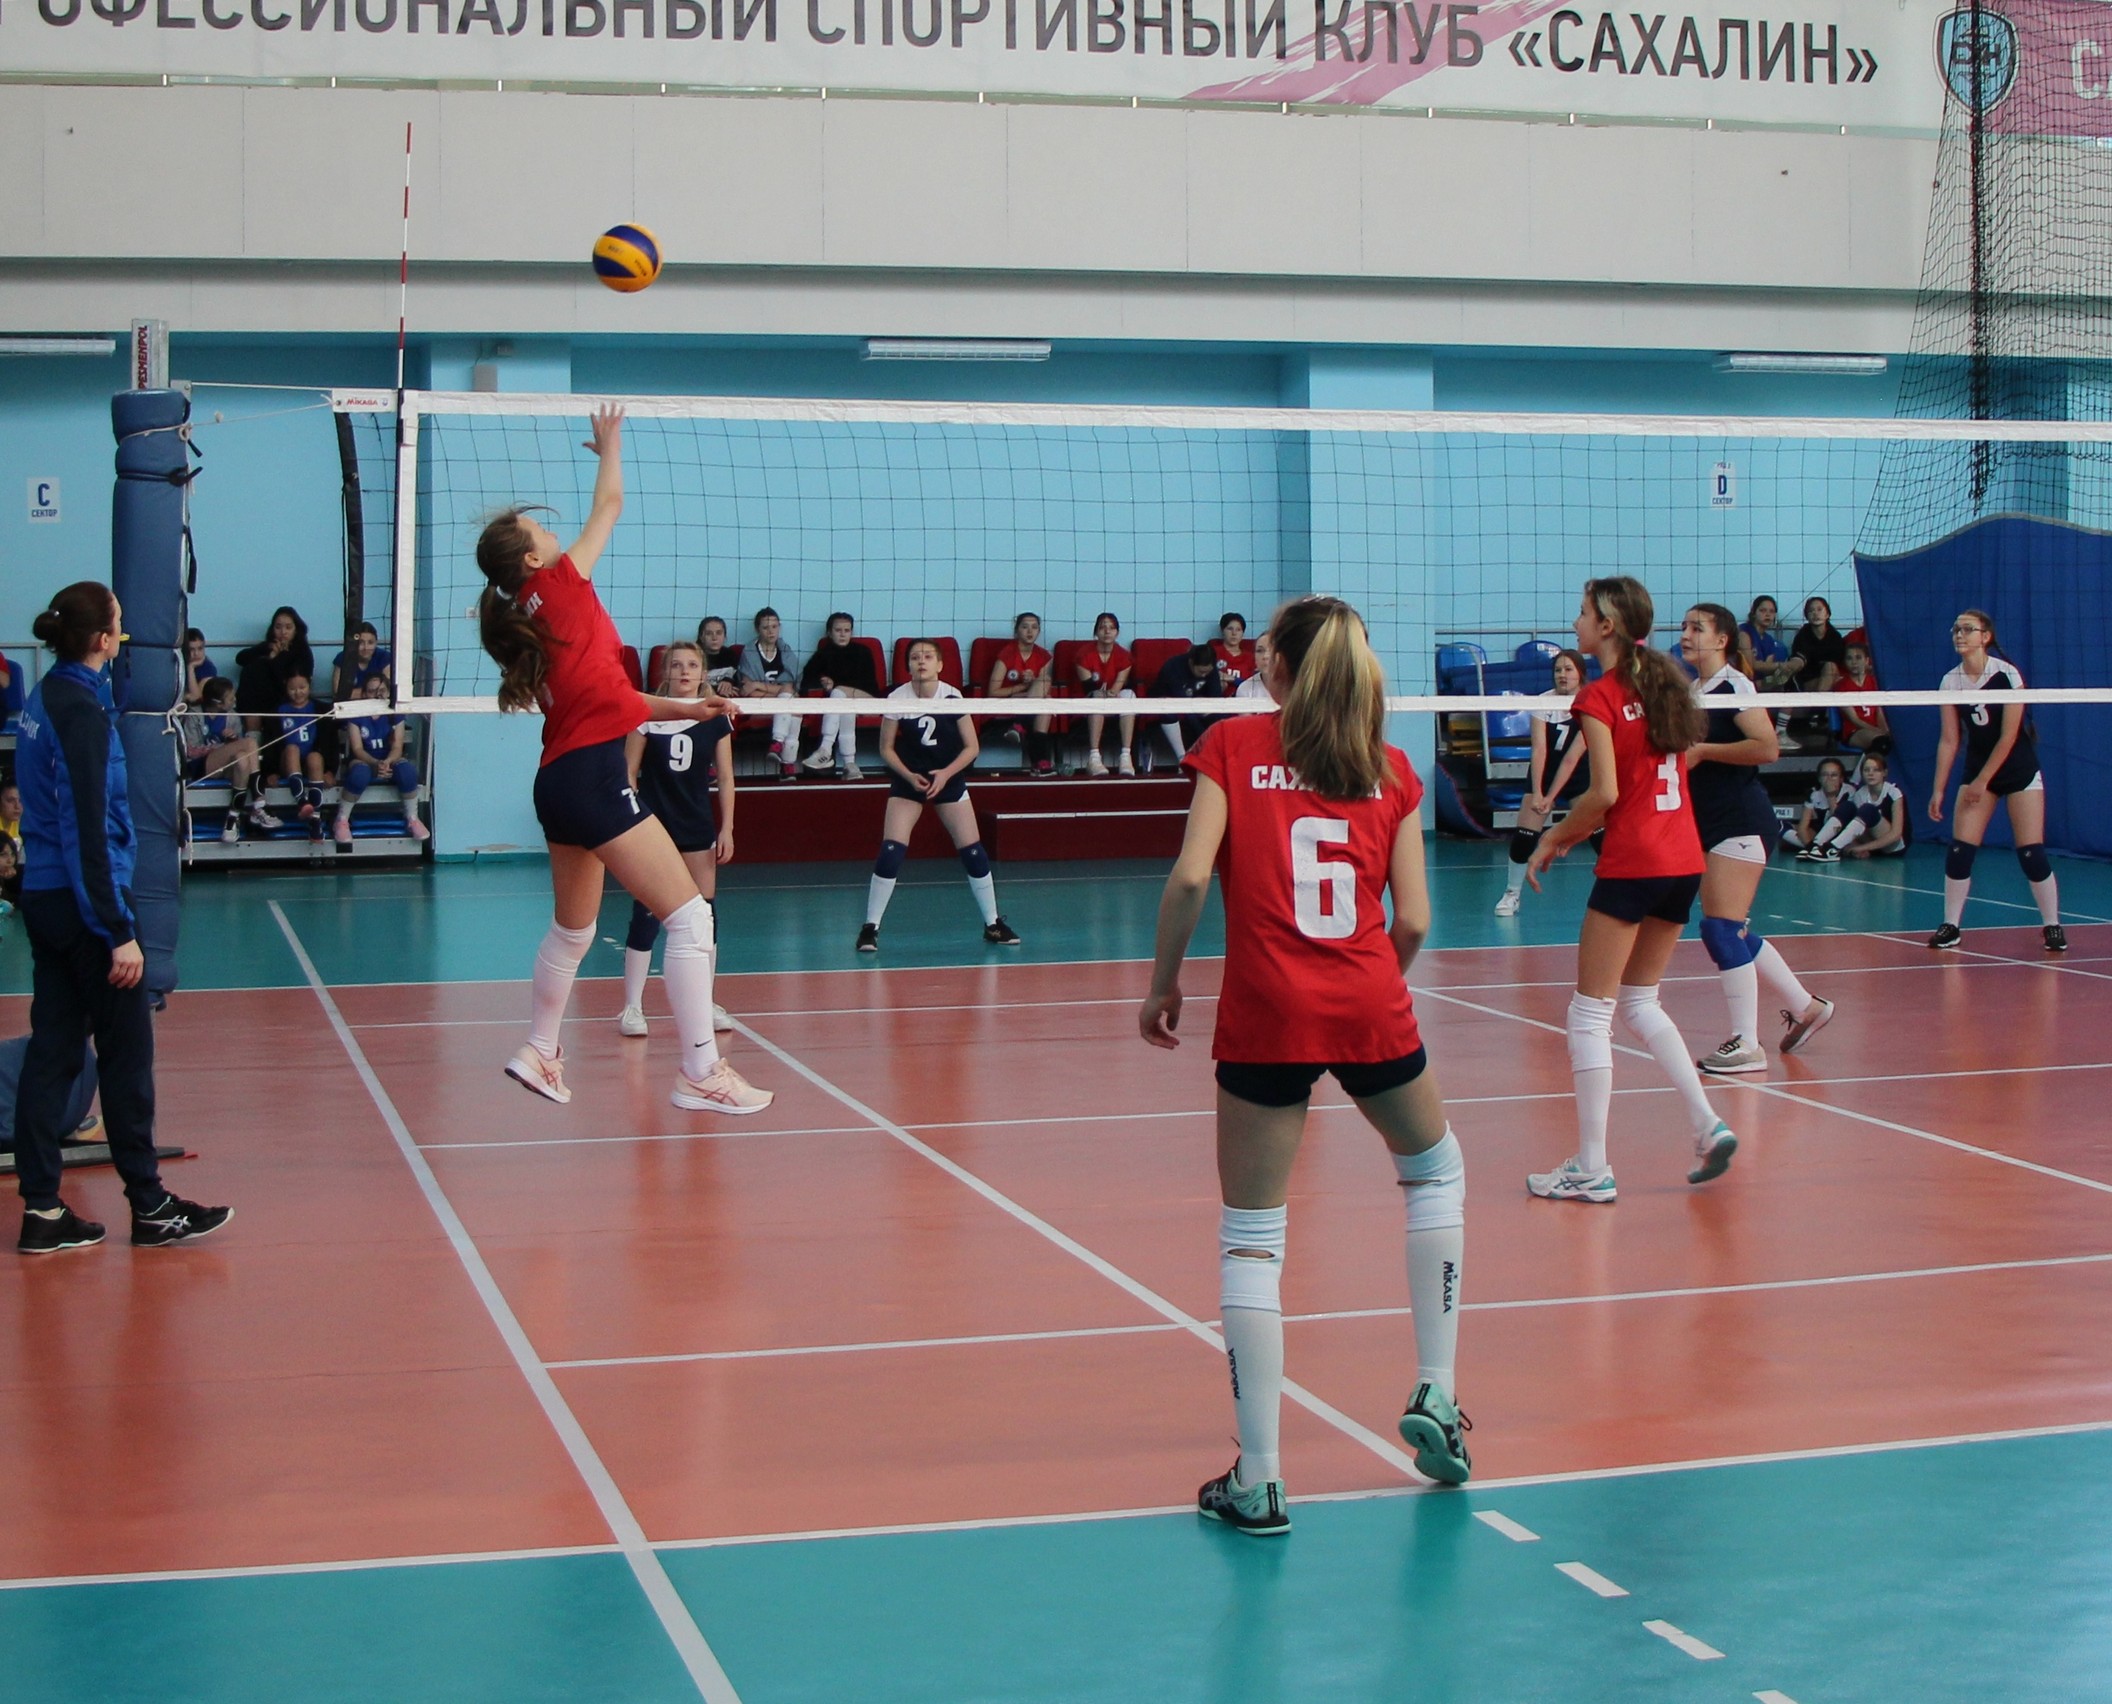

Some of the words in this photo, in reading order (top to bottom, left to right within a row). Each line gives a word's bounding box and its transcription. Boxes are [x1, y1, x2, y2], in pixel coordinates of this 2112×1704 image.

[807, 0, 1287, 60] СПОРТИВНЫЙ
[1315, 0, 1484, 67] КЛУБ
[1508, 10, 1878, 85] «САХАЛИН»
[38, 483, 50, 507] C
[1717, 475, 1727, 495] D
[299, 726, 309, 742] 6
[917, 715, 937, 746] 2
[1554, 723, 1570, 751] 7
[669, 733, 693, 772] 9
[1655, 752, 1682, 812] 3
[1290, 816, 1358, 940] 6
